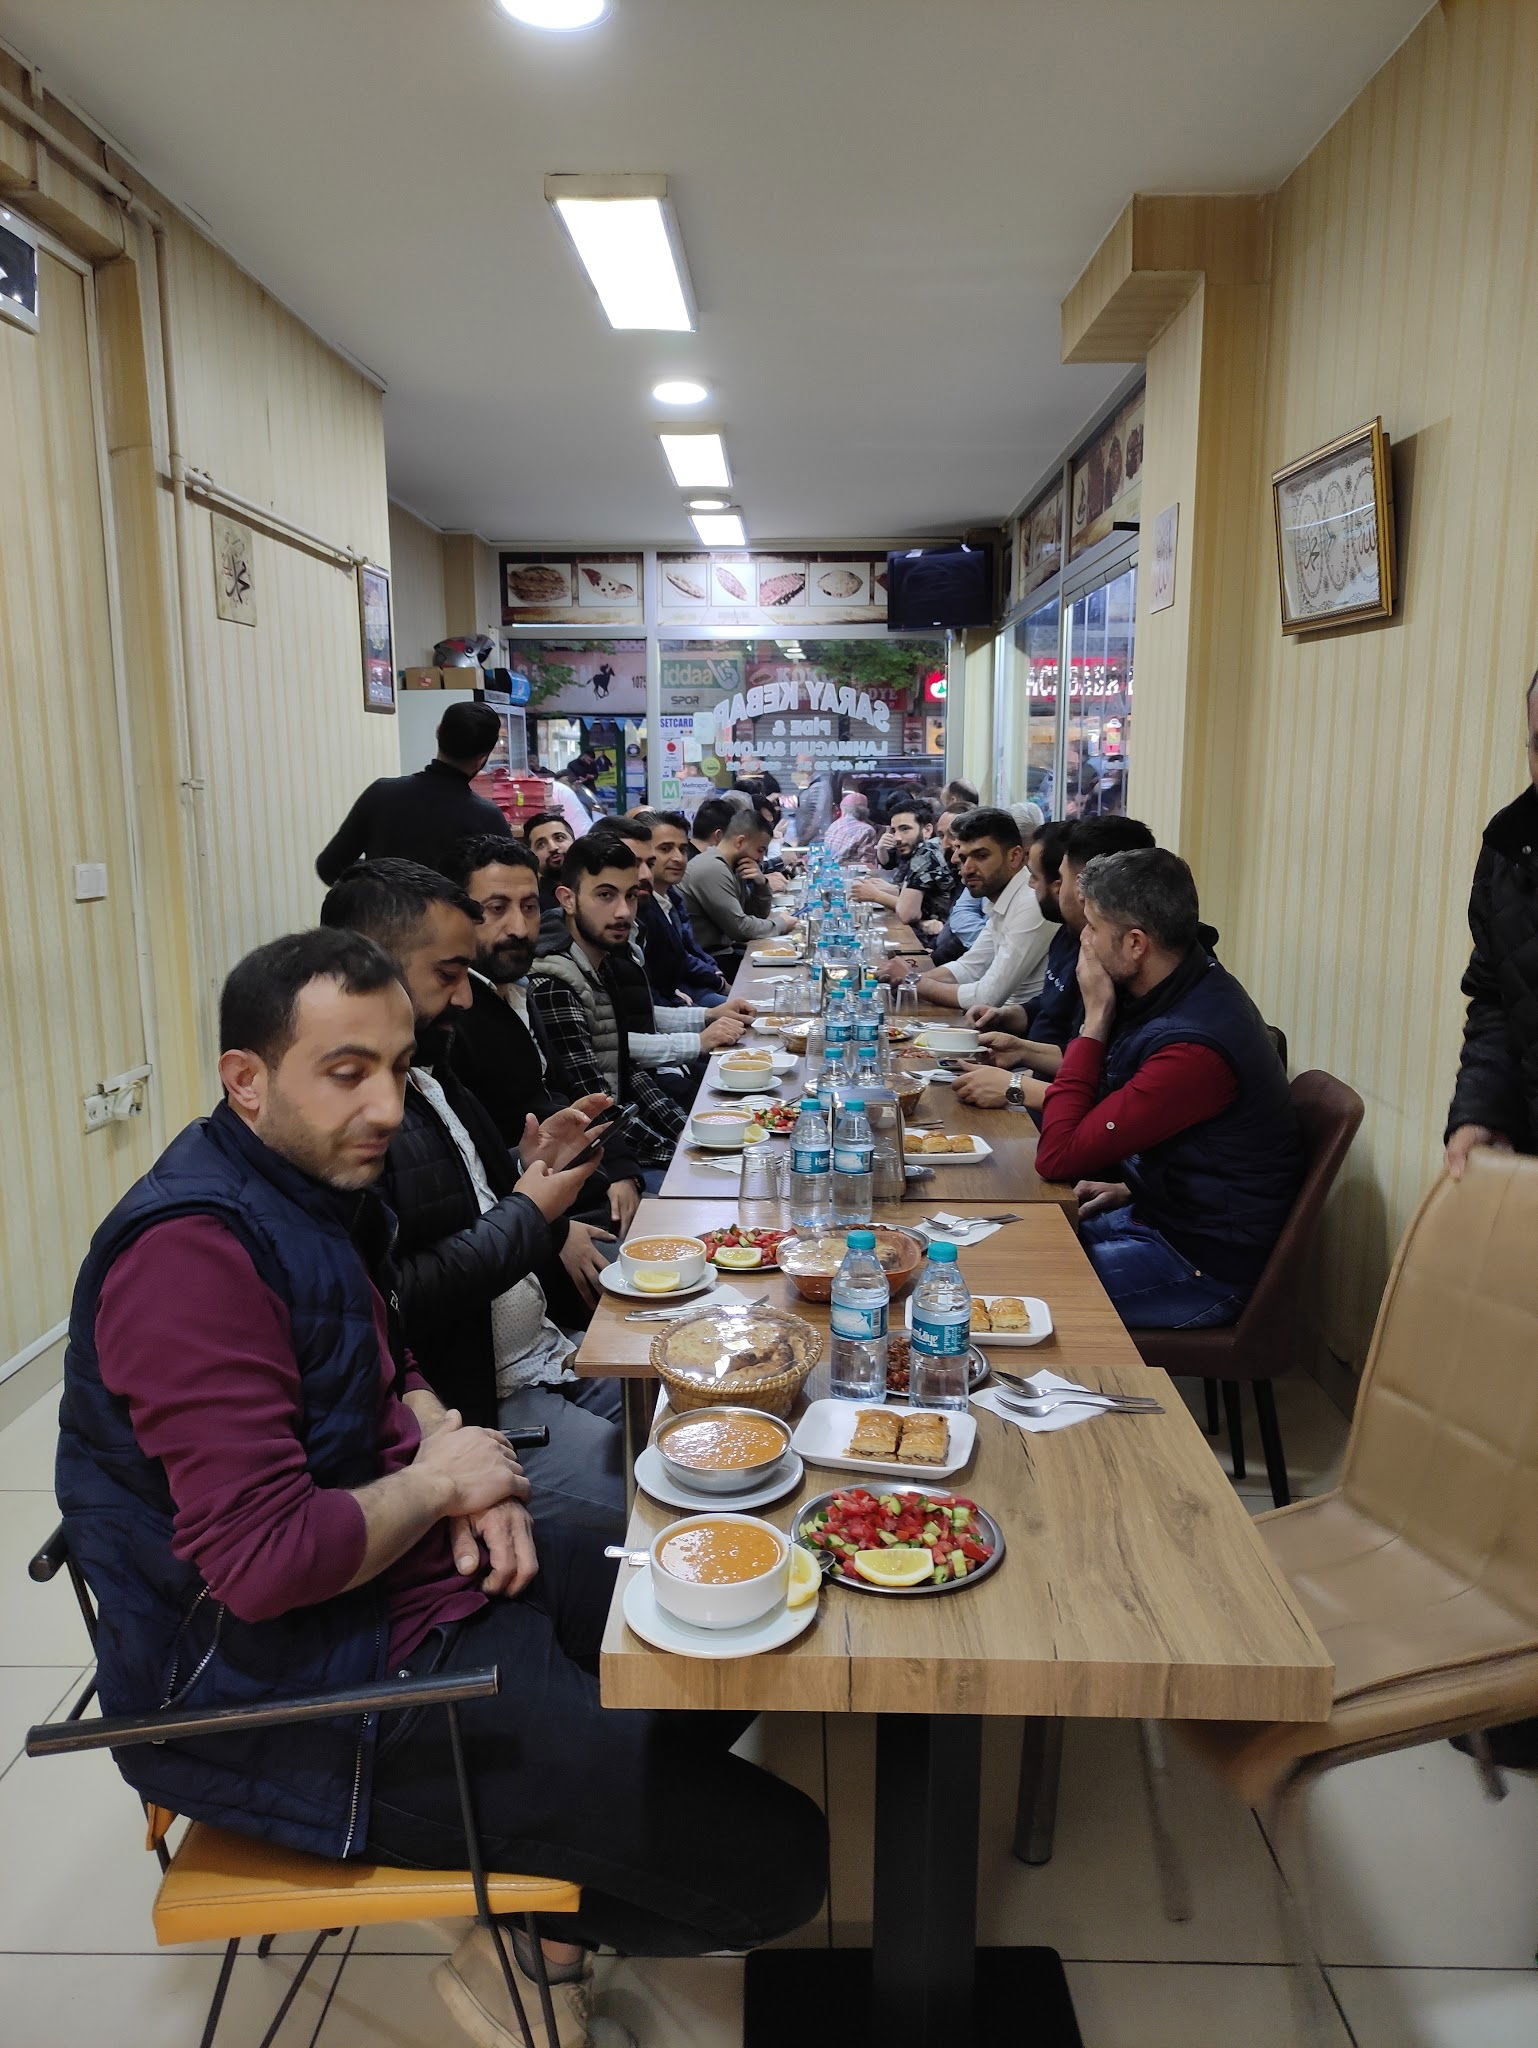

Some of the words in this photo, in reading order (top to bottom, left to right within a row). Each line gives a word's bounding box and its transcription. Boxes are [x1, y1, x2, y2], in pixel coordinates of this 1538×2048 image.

[663, 664, 713, 686] iddaa
[670, 696, 699, 705] SPOR
[660, 718, 694, 728] SETCARD
